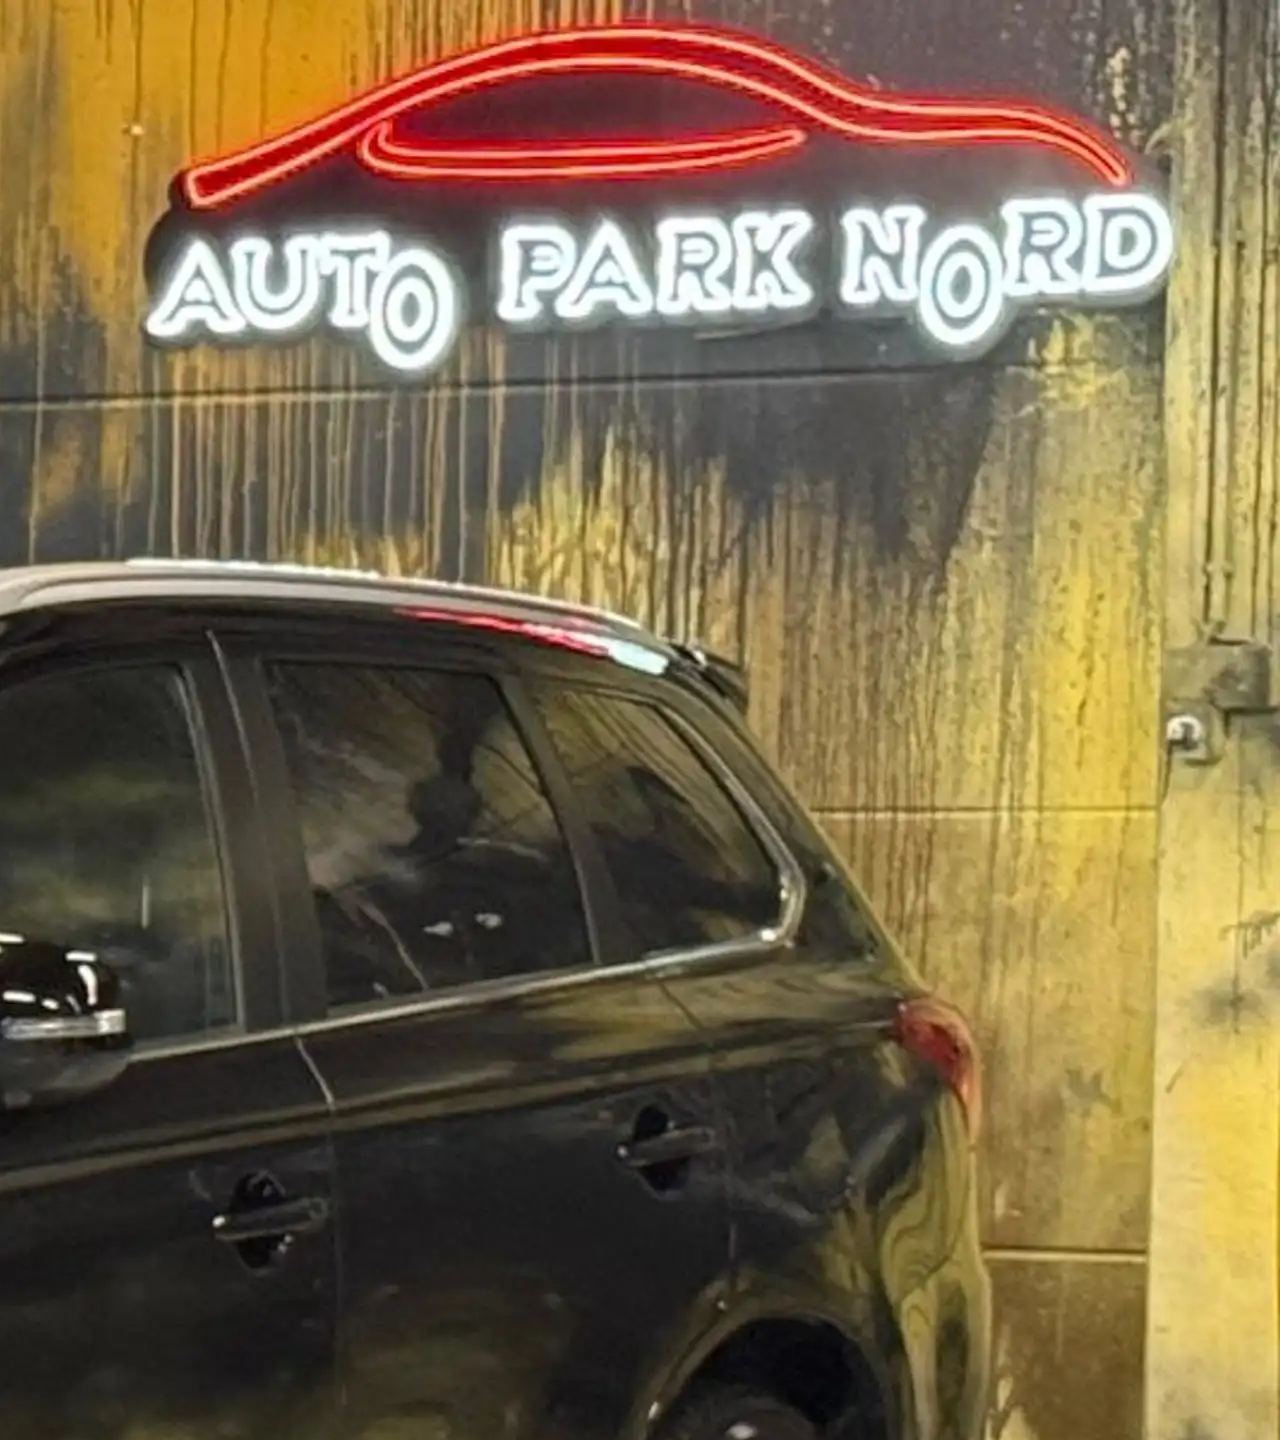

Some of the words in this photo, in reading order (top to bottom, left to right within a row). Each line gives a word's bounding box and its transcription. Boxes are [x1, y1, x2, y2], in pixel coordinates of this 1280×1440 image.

[146, 230, 454, 369] AUTO
[497, 209, 814, 320] PARK
[841, 194, 1174, 345] NORD
